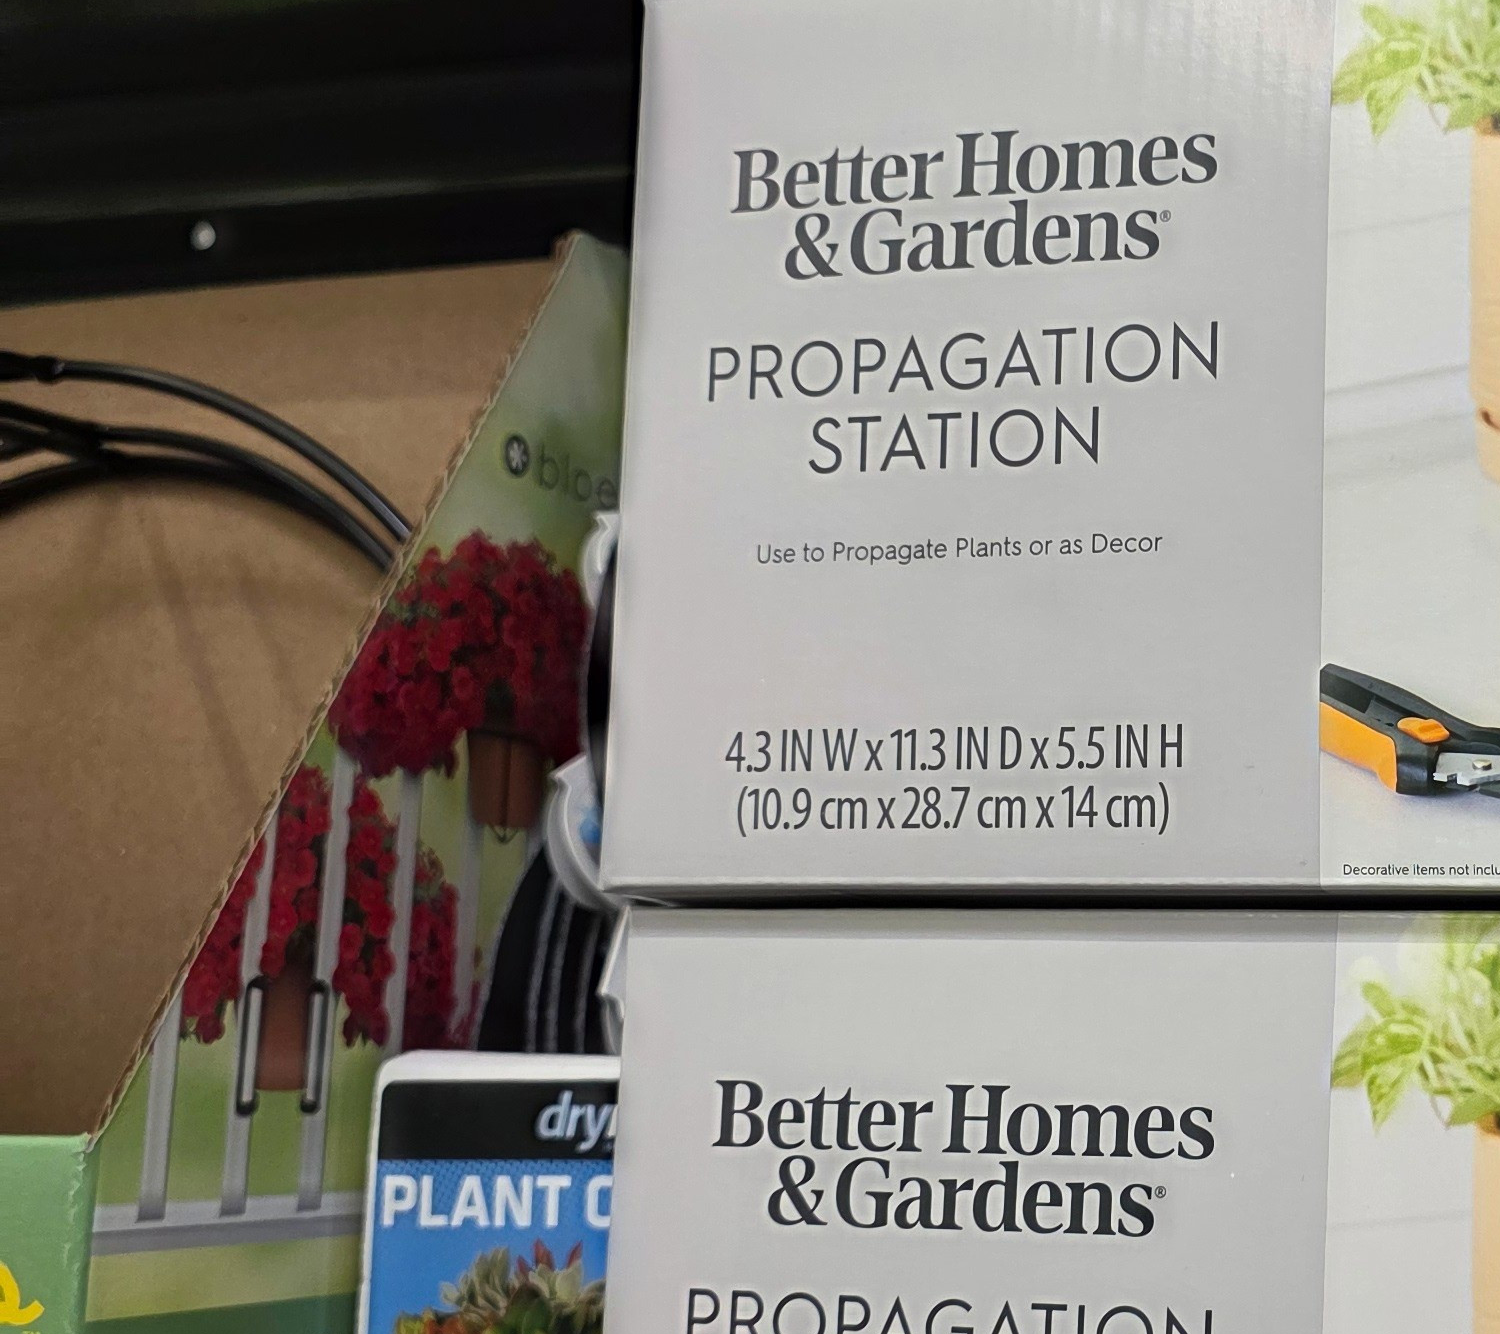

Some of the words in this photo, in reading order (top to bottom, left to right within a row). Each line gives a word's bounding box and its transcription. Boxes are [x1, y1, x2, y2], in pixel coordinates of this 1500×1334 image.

[730, 144, 944, 213] Better
[953, 129, 1218, 199] Homes
[707, 321, 1218, 402] PROPAGATION
[808, 406, 1100, 474] STATION
[756, 543, 796, 564] Use
[803, 542, 824, 563] to
[833, 539, 947, 566] Propagate
[955, 536, 1022, 558] Plants
[1029, 536, 1053, 556] or
[1059, 536, 1083, 555] as
[1091, 532, 1163, 555] Decor
[822, 728, 858, 771] W
[1161, 723, 1184, 768] H
[736, 786, 812, 837] (10.9
[820, 795, 868, 830] cm
[977, 794, 1026, 829] cm
[1105, 782, 1170, 835] cm)
[1343, 864, 1410, 876] Decorative
[1413, 864, 1446, 876] items
[1449, 864, 1470, 876] not
[712, 1079, 934, 1154] Better
[942, 1083, 1215, 1160] Homes
[382, 1174, 571, 1228] PLANT
